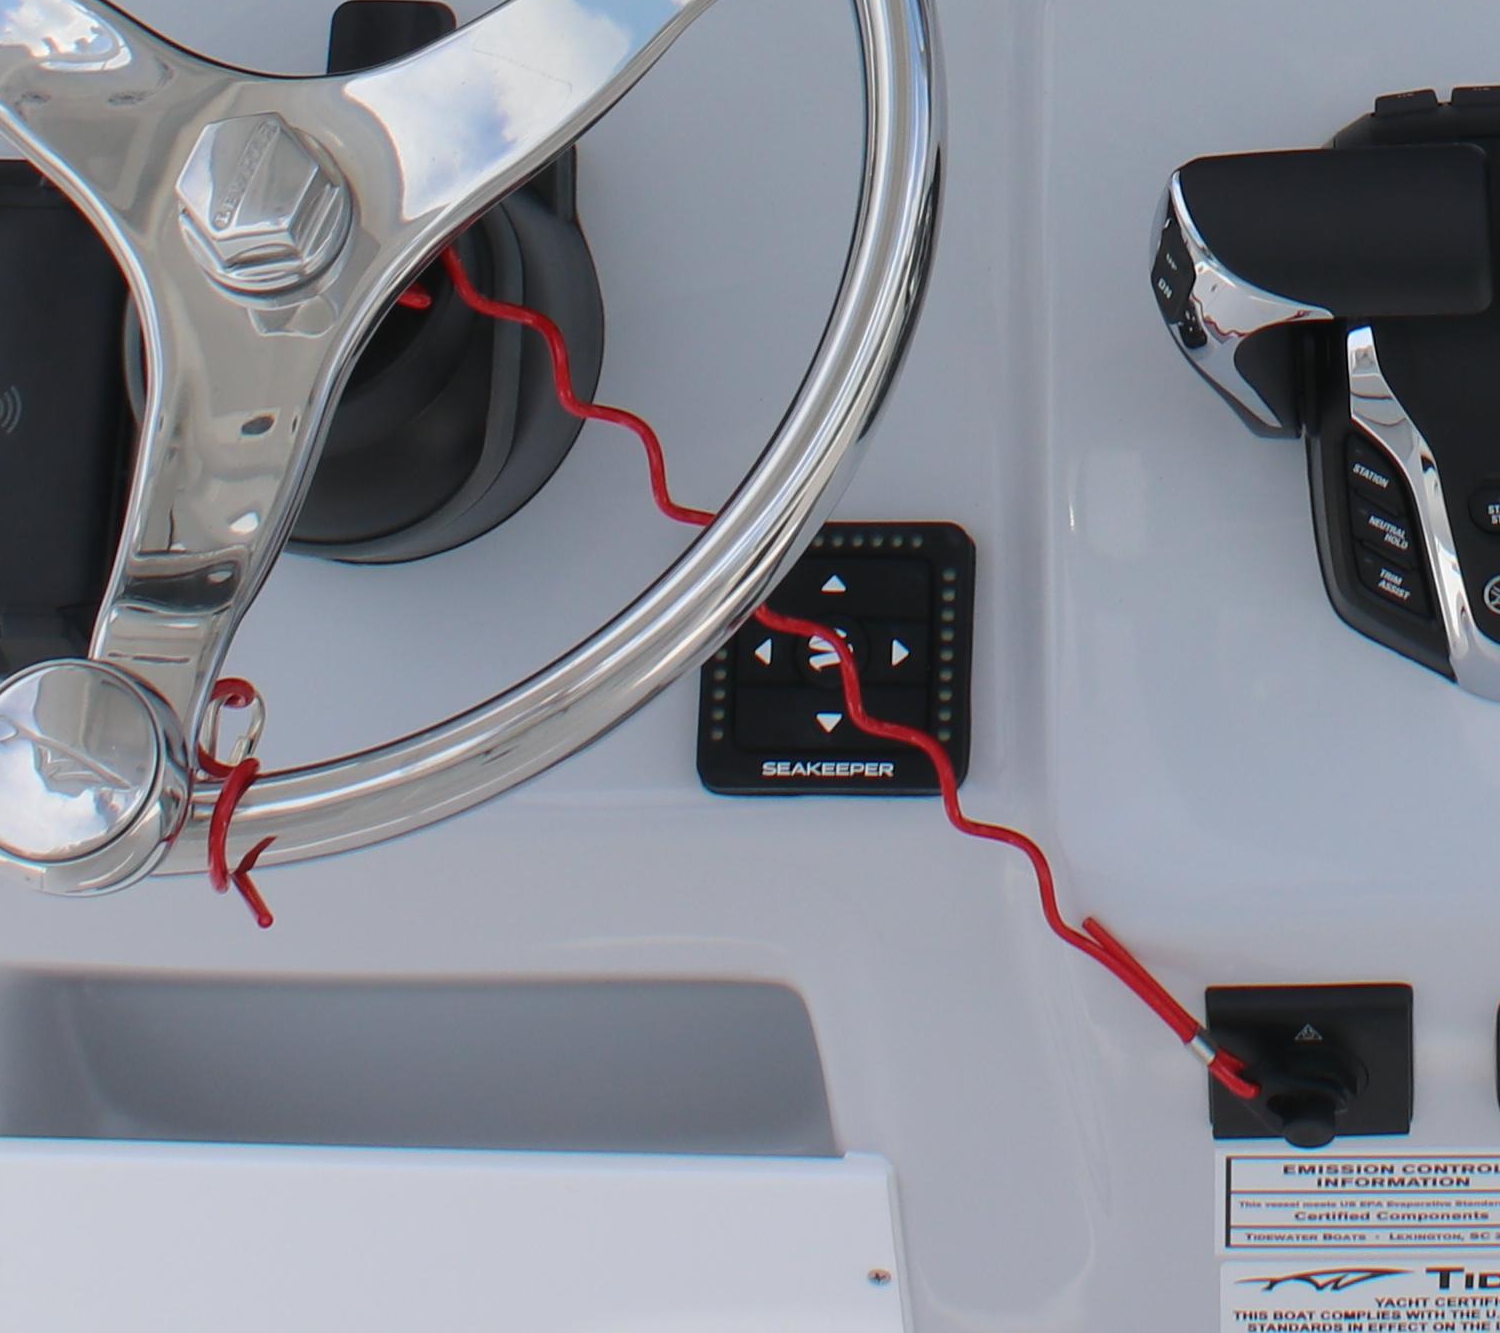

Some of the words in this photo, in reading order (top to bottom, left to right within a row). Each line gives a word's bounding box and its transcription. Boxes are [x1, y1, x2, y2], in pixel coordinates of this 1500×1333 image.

[1352, 463, 1389, 489] STATION
[1368, 514, 1407, 539] NEUTRAL
[1384, 532, 1409, 550] HOLD
[1379, 568, 1403, 585] TRIM
[1378, 580, 1411, 601] ASSIST
[761, 761, 894, 777] SEAKEEPER
[1283, 1163, 1395, 1176] EMISSION
[1316, 1176, 1471, 1188] INFORMATION
[1294, 1211, 1370, 1221] Certified
[1376, 1210, 1489, 1222] Components
[1245, 1233, 1318, 1241] TIDEWATER
[1322, 1233, 1366, 1241] BOATS
[1469, 1231, 1490, 1240] SC
[1374, 1296, 1430, 1308] YACHT
[1234, 1310, 1269, 1321] THIS
[1273, 1310, 1316, 1321] BOAT
[1320, 1309, 1401, 1321] COMPLIES
[1405, 1309, 1445, 1320] WITH
[1451, 1309, 1481, 1320] THE
[1247, 1322, 1344, 1332] STANDARDS
[1349, 1322, 1363, 1331] IN
[1368, 1321, 1428, 1331] EFFECT
[1432, 1321, 1456, 1331] ON
[1460, 1320, 1491, 1331] THE
